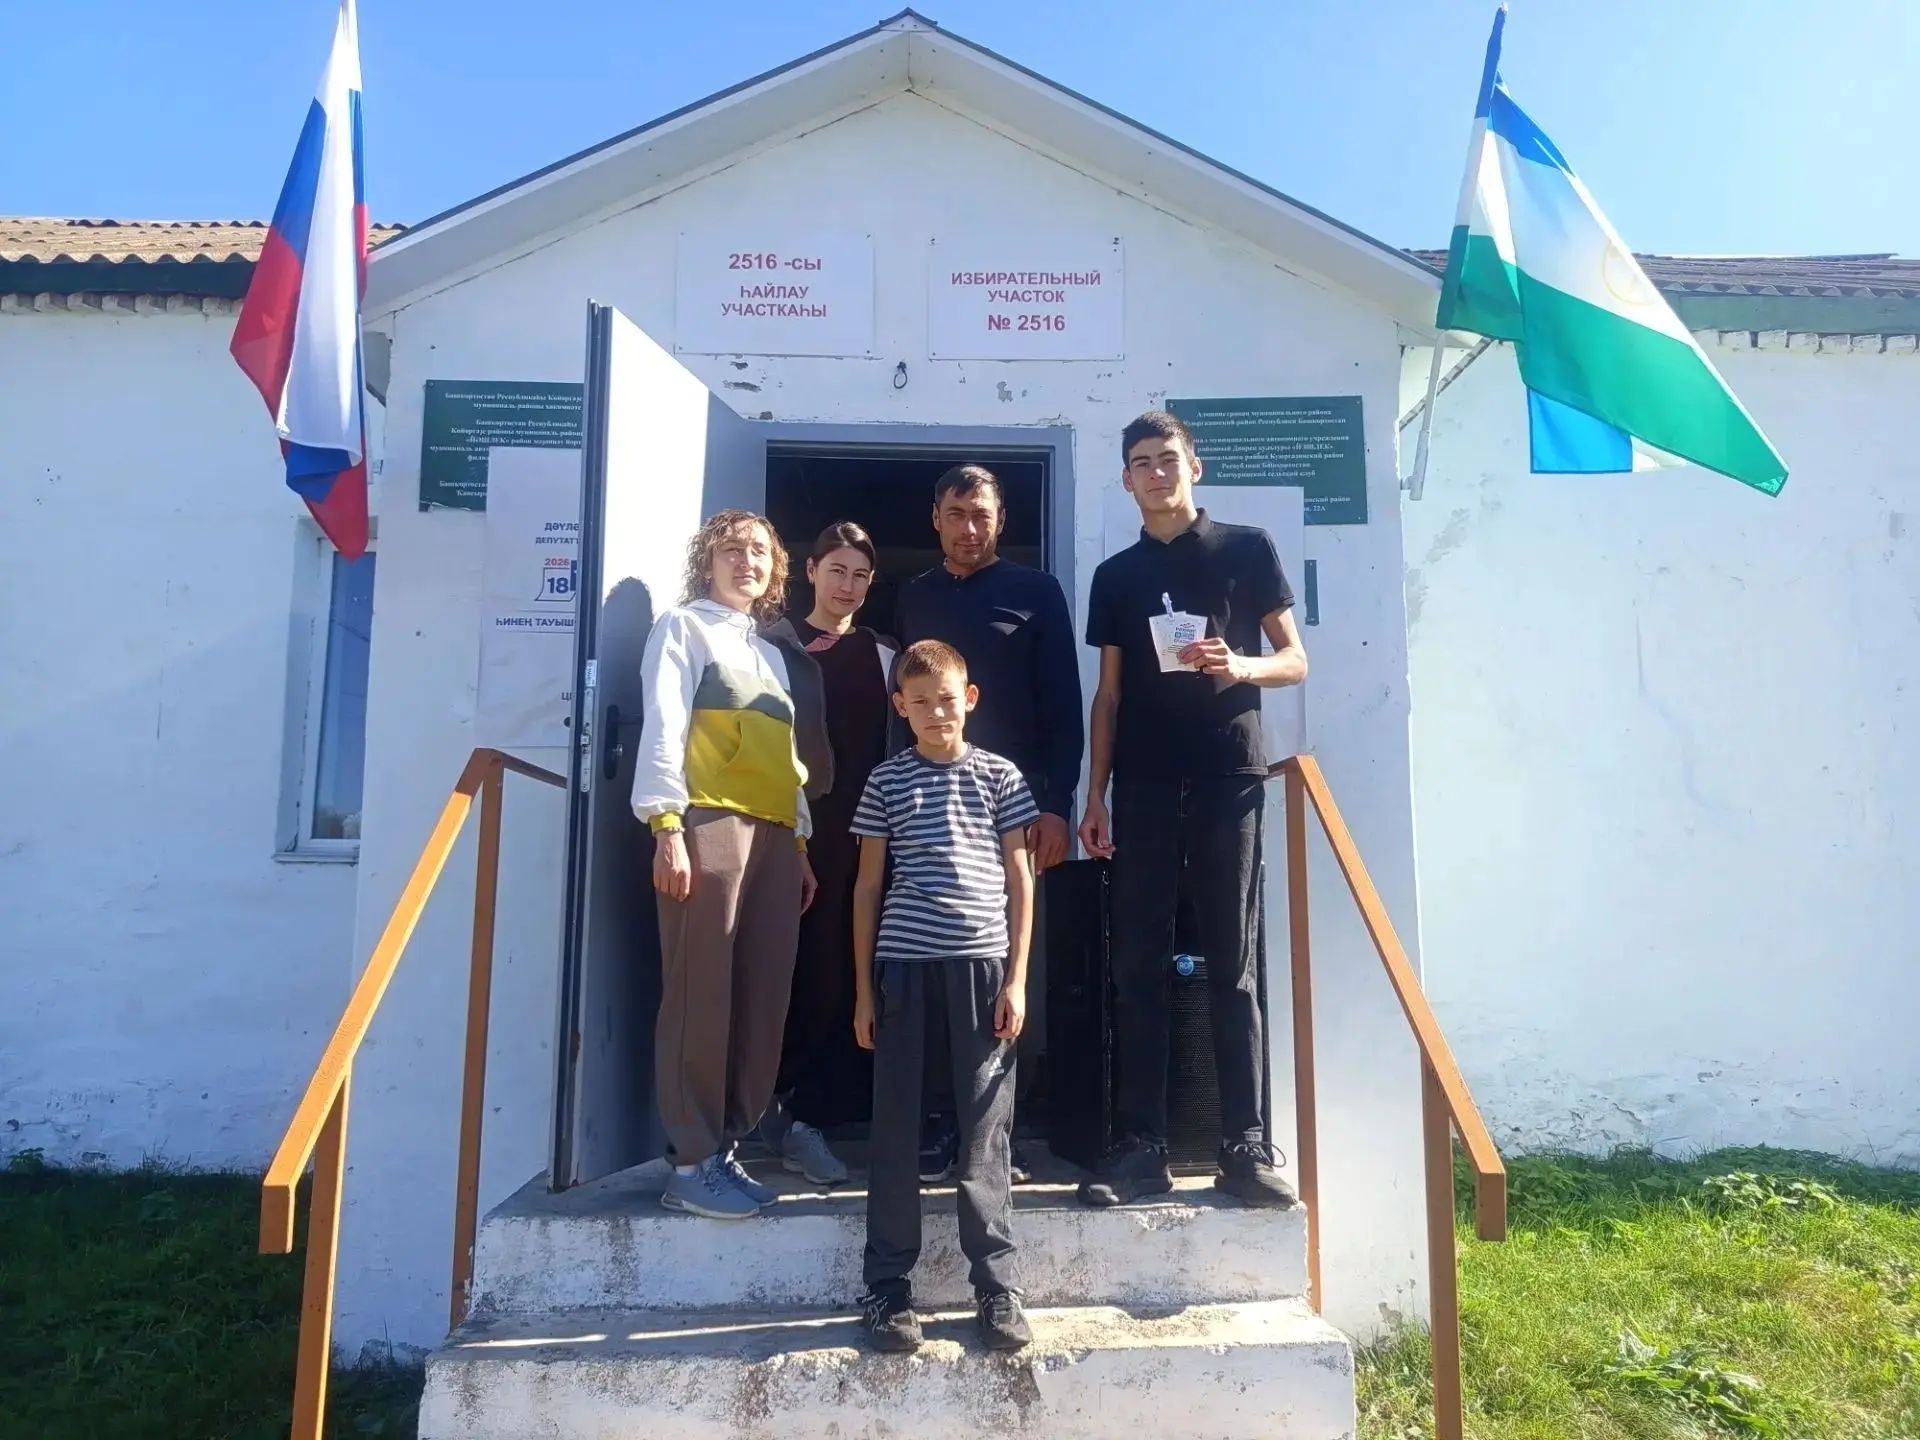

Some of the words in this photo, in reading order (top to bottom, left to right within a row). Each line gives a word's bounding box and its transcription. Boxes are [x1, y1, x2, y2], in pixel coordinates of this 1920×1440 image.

[728, 253, 778, 270] 2516
[784, 255, 822, 271] -сы
[951, 269, 1101, 287] ИЗБИРАТЕЛЬНЫЙ
[740, 282, 810, 299] ҺАЙЛАУ
[987, 289, 1065, 304] УЧАСТОК
[721, 302, 827, 319] УЧАСТКАҺЫ
[987, 314, 1011, 331] №
[1017, 314, 1066, 332] 2516
[544, 522, 580, 531] ДӘҮЛӘ
[547, 577, 569, 594] 18
[535, 619, 576, 627] ТАУЫШ
